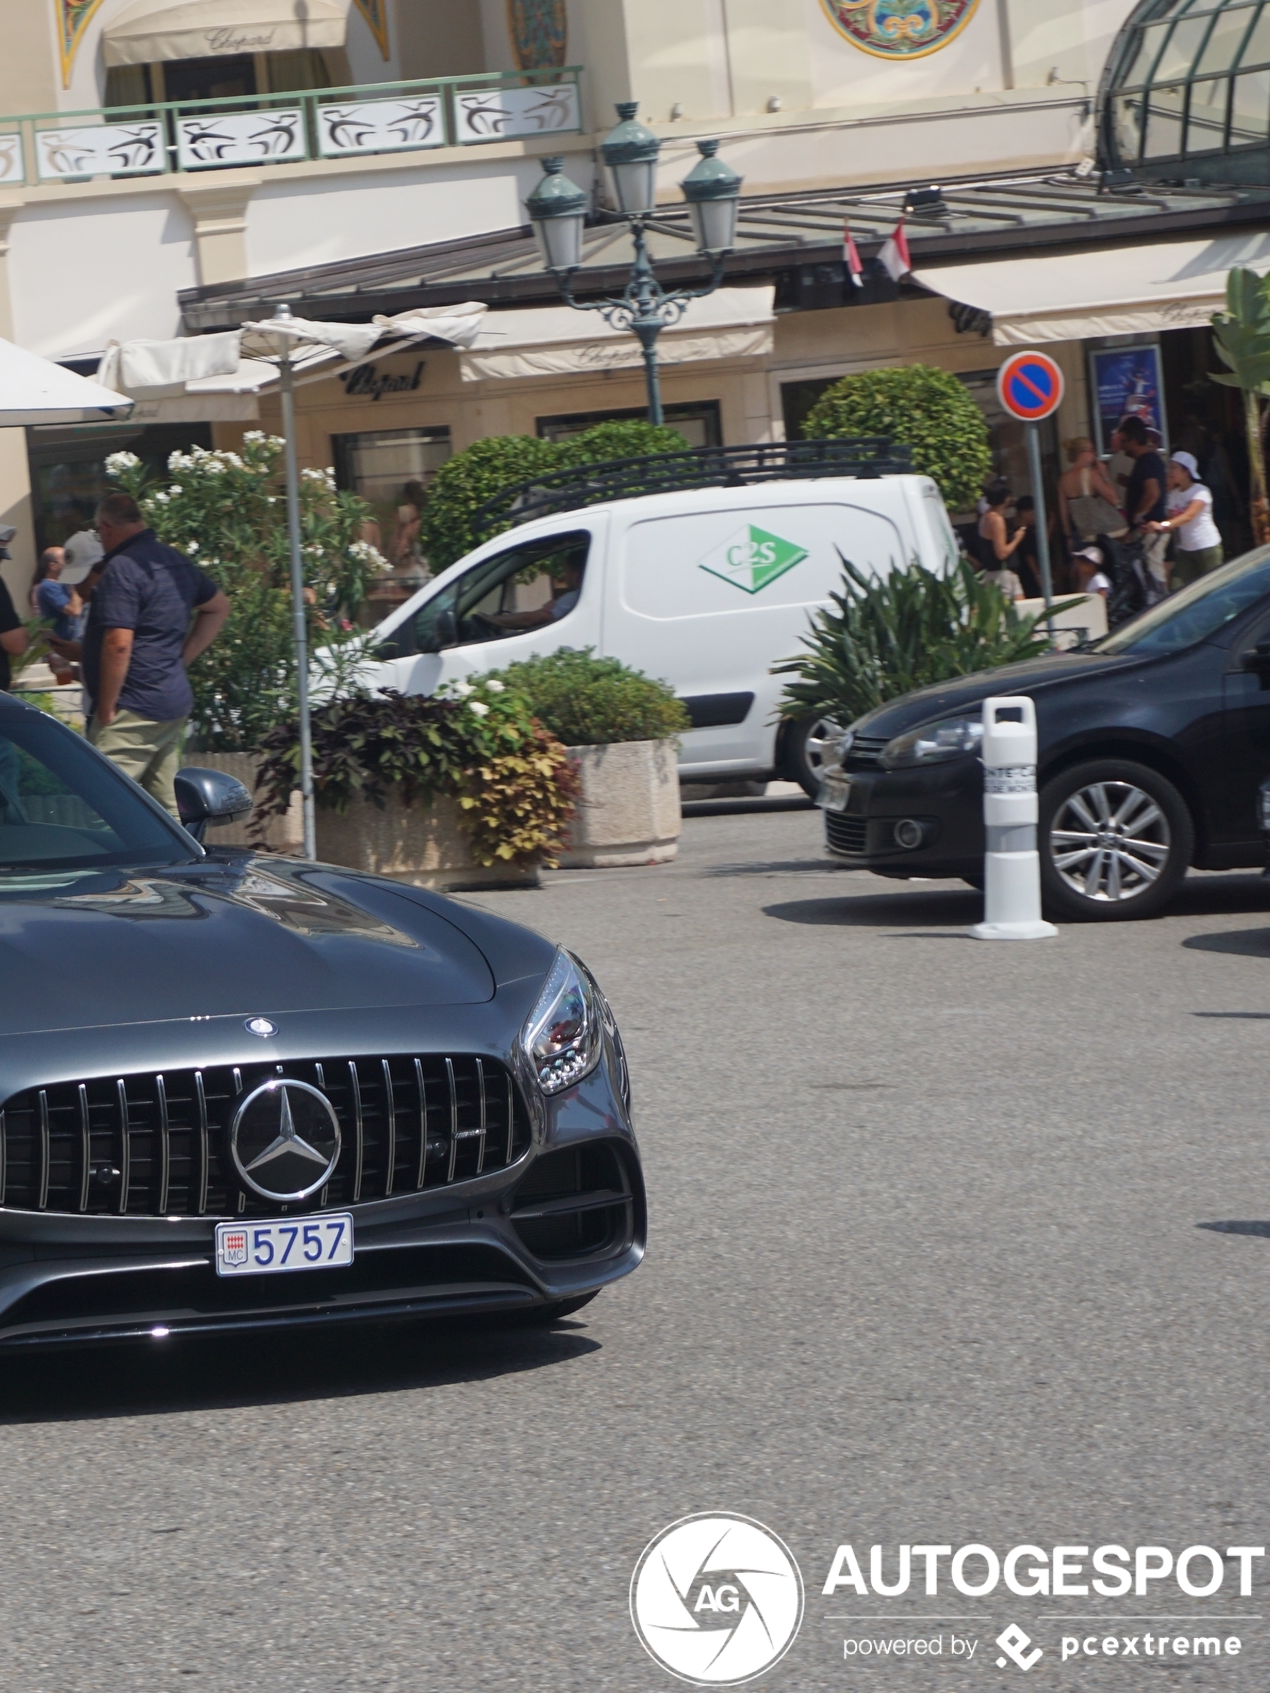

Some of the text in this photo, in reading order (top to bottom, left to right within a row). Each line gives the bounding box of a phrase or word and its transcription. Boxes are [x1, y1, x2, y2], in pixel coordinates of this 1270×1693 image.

[204, 26, 277, 51] Chopard
[726, 541, 777, 566] C2S
[228, 1250, 244, 1261] MC
[253, 1222, 346, 1266] 5757
